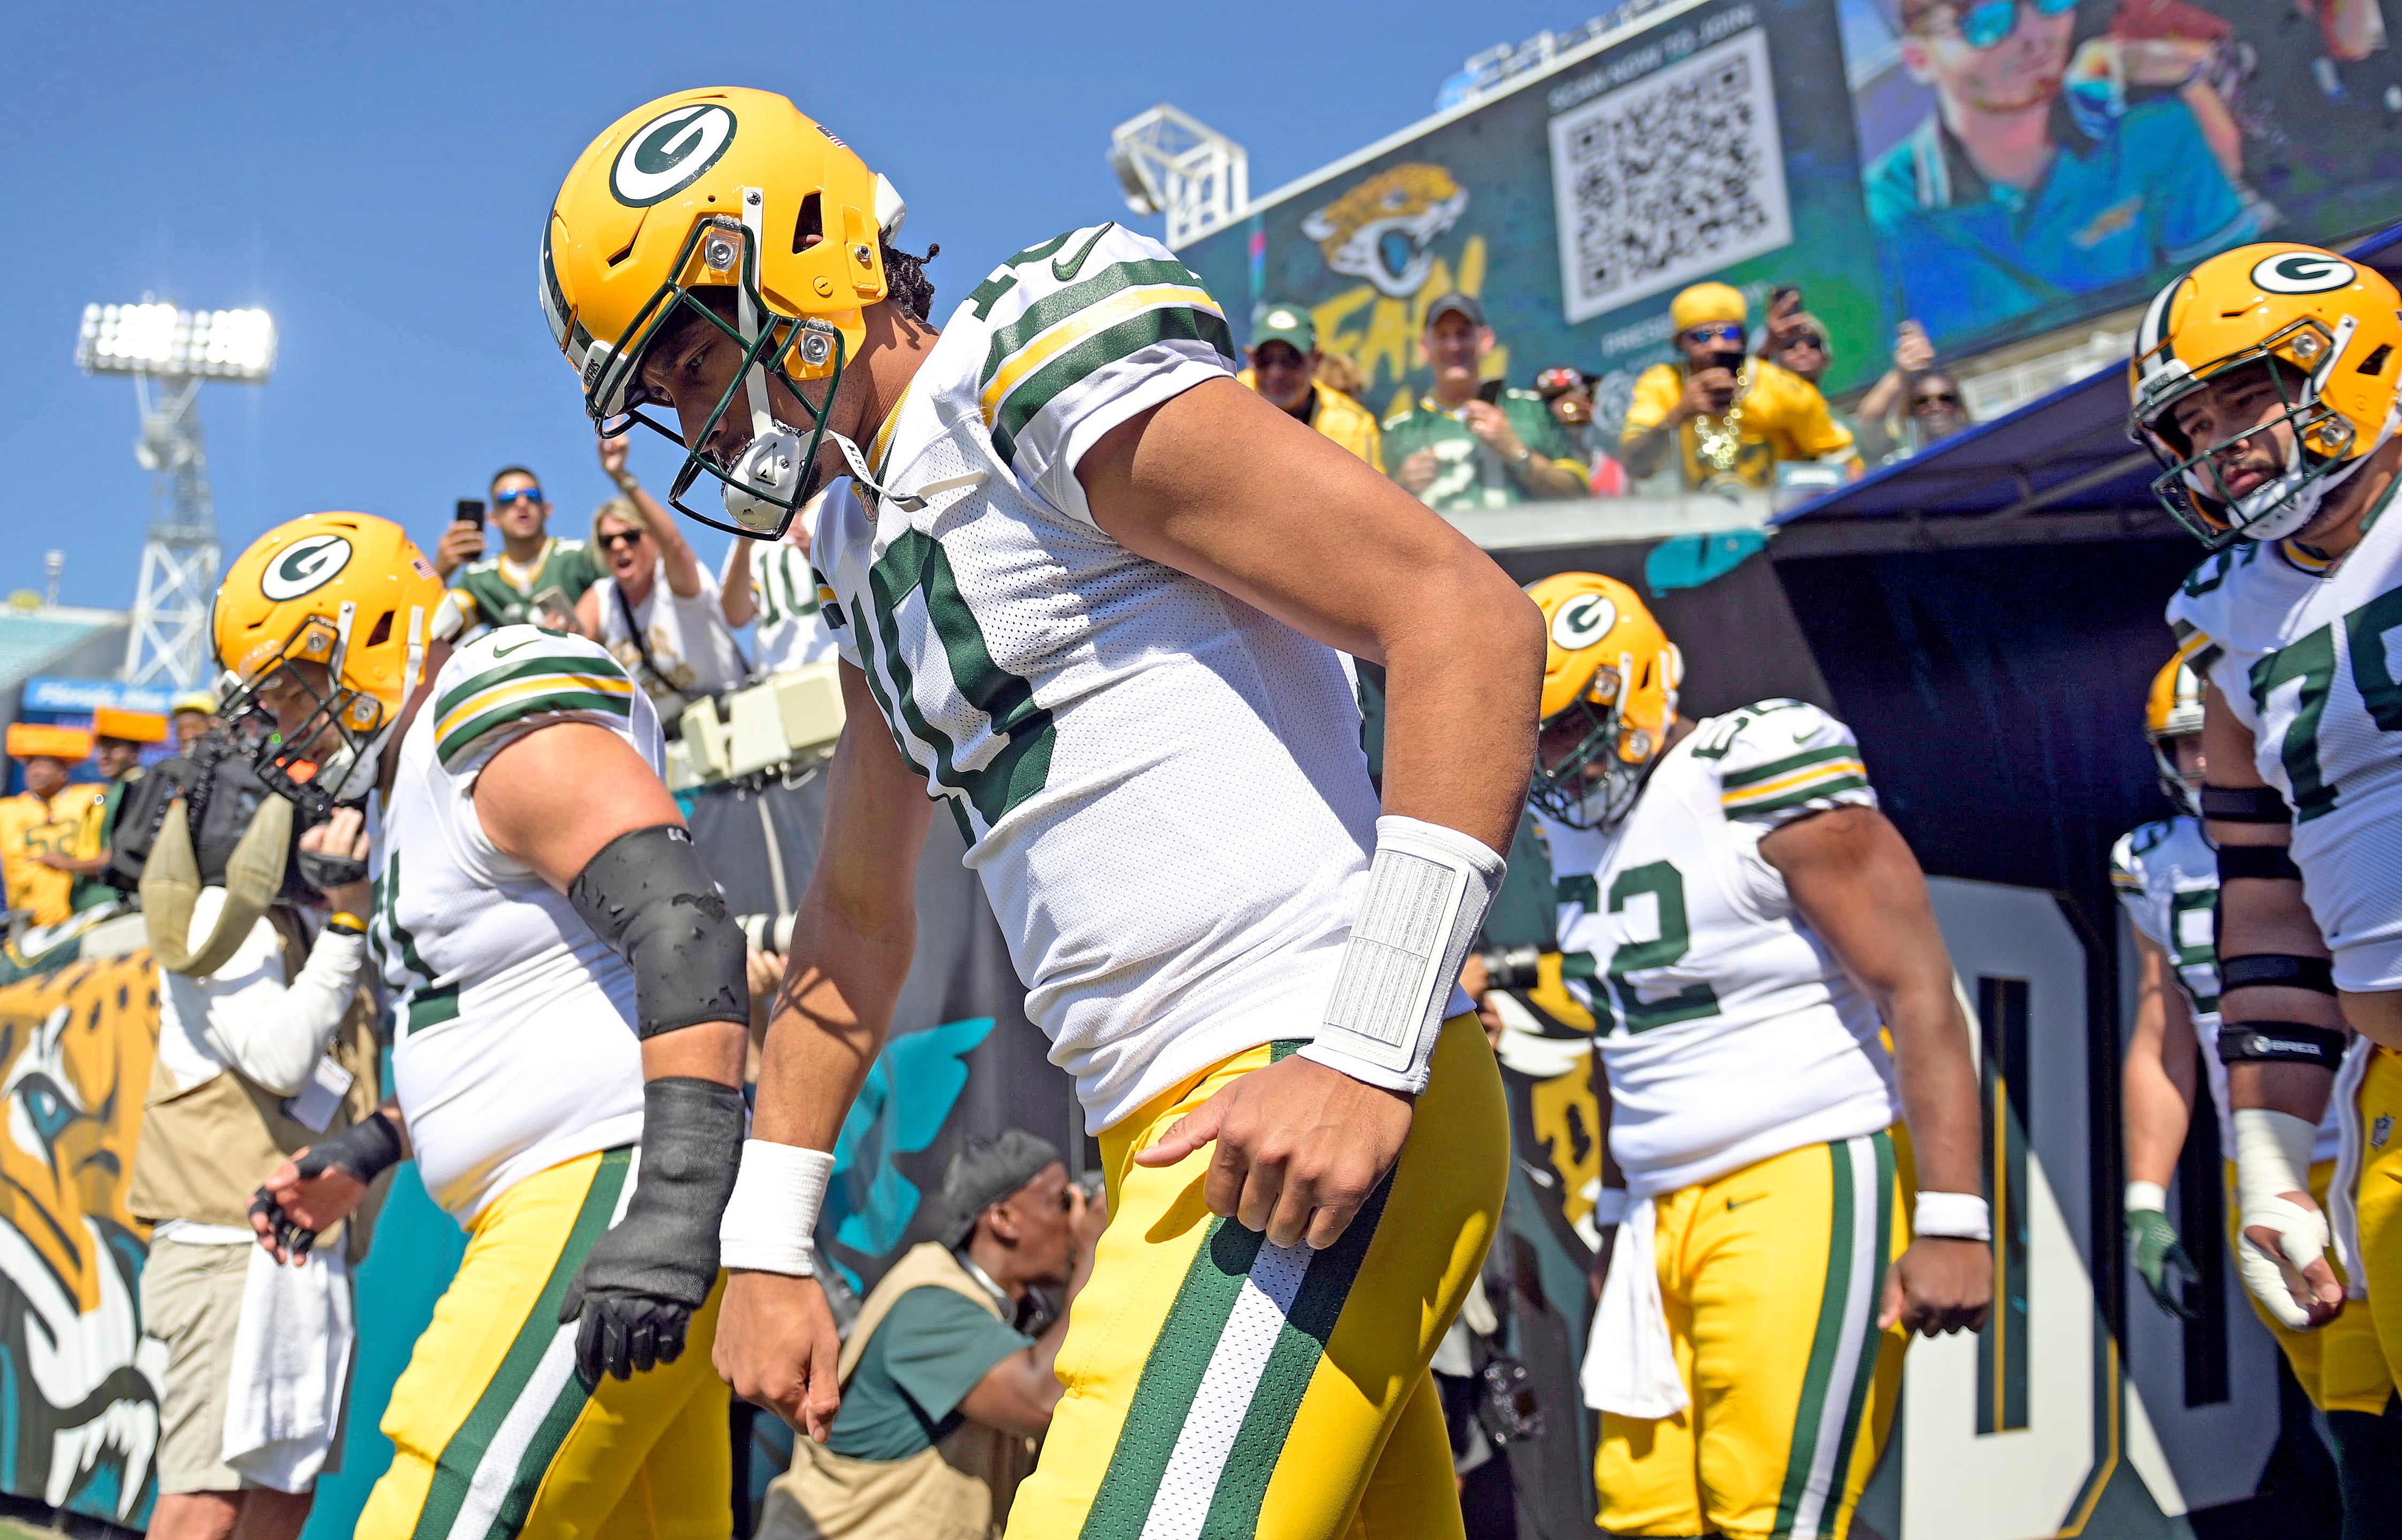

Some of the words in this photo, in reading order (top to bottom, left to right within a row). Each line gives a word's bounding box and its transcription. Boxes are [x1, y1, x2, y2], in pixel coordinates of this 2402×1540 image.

[609, 103, 737, 207] G
[2251, 250, 2356, 295] G
[261, 533, 353, 603] G
[759, 547, 820, 628] 10
[1551, 593, 1616, 651] G
